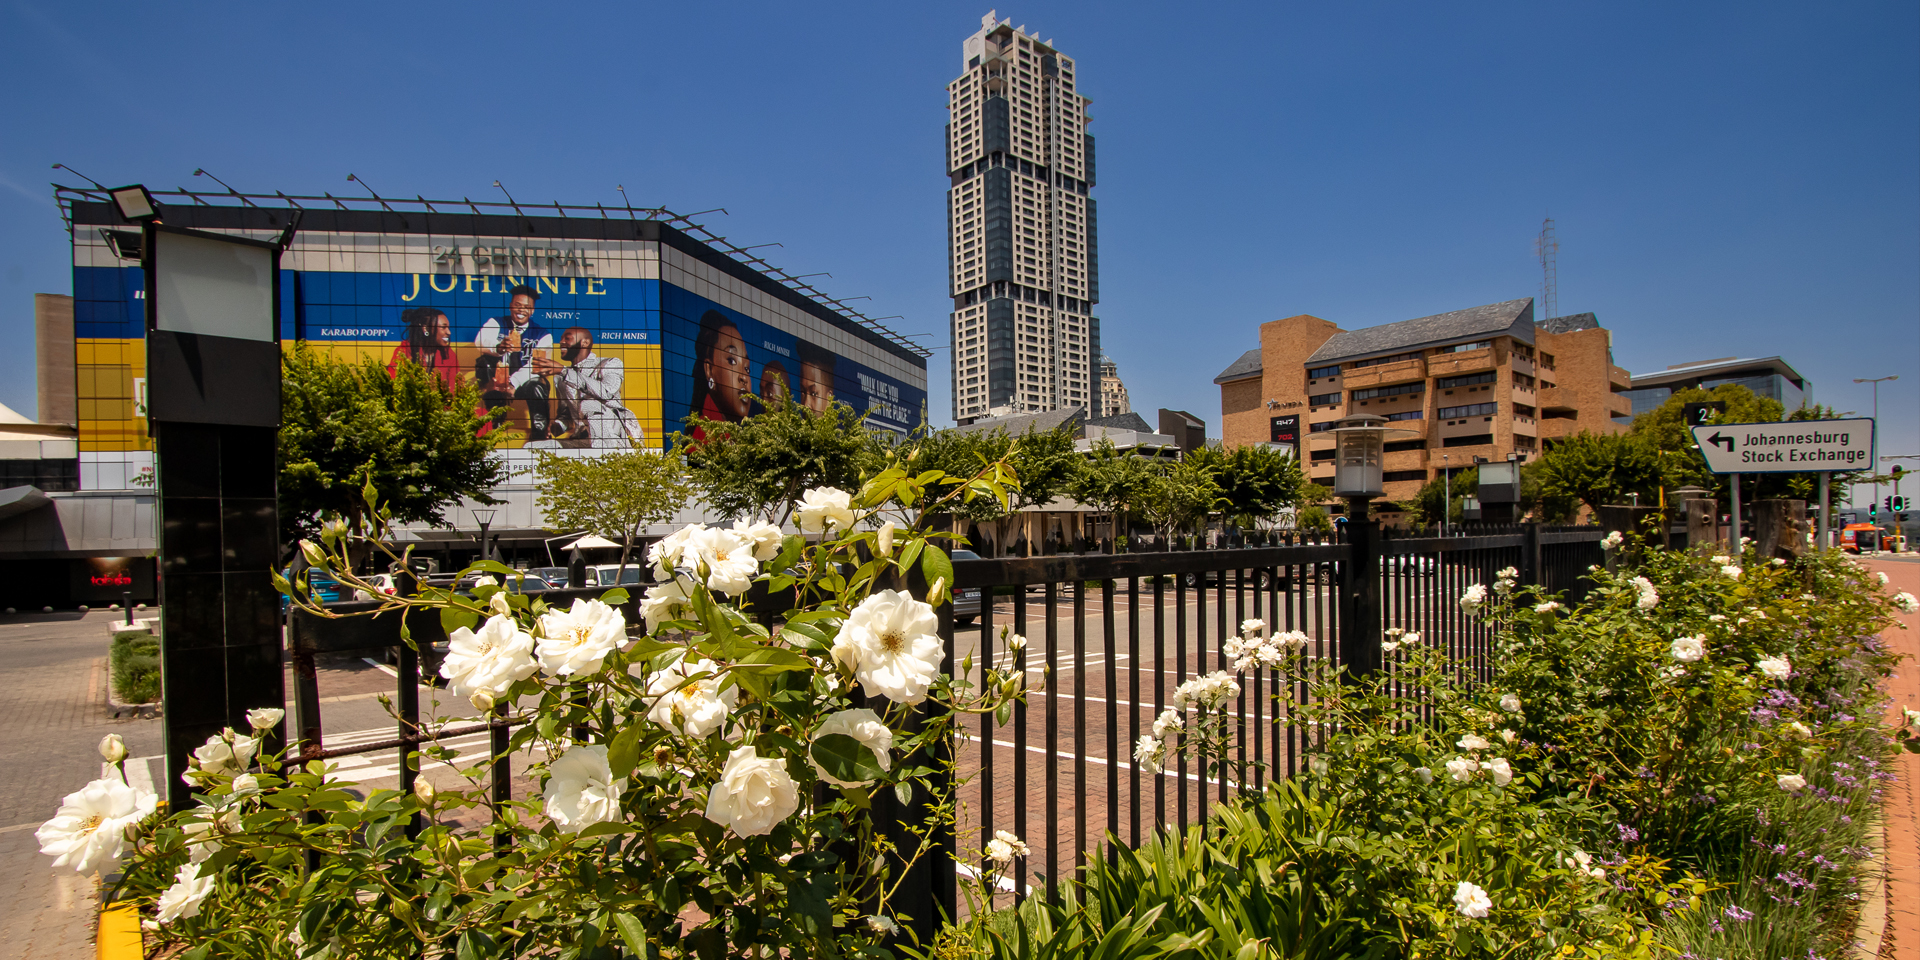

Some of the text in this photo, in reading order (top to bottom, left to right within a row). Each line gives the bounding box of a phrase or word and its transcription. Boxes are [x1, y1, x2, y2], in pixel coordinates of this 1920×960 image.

[432, 244, 595, 268] 24 CENTRAL
[545, 312, 574, 320] NASTY
[321, 328, 390, 337] KARABO POPPY
[601, 332, 647, 340] RICH MNISI
[876, 380, 888, 399] LIKE
[888, 384, 899, 403] YOU
[1743, 431, 1850, 447] Johannesburg
[1742, 448, 1866, 464] Stock Exchange
